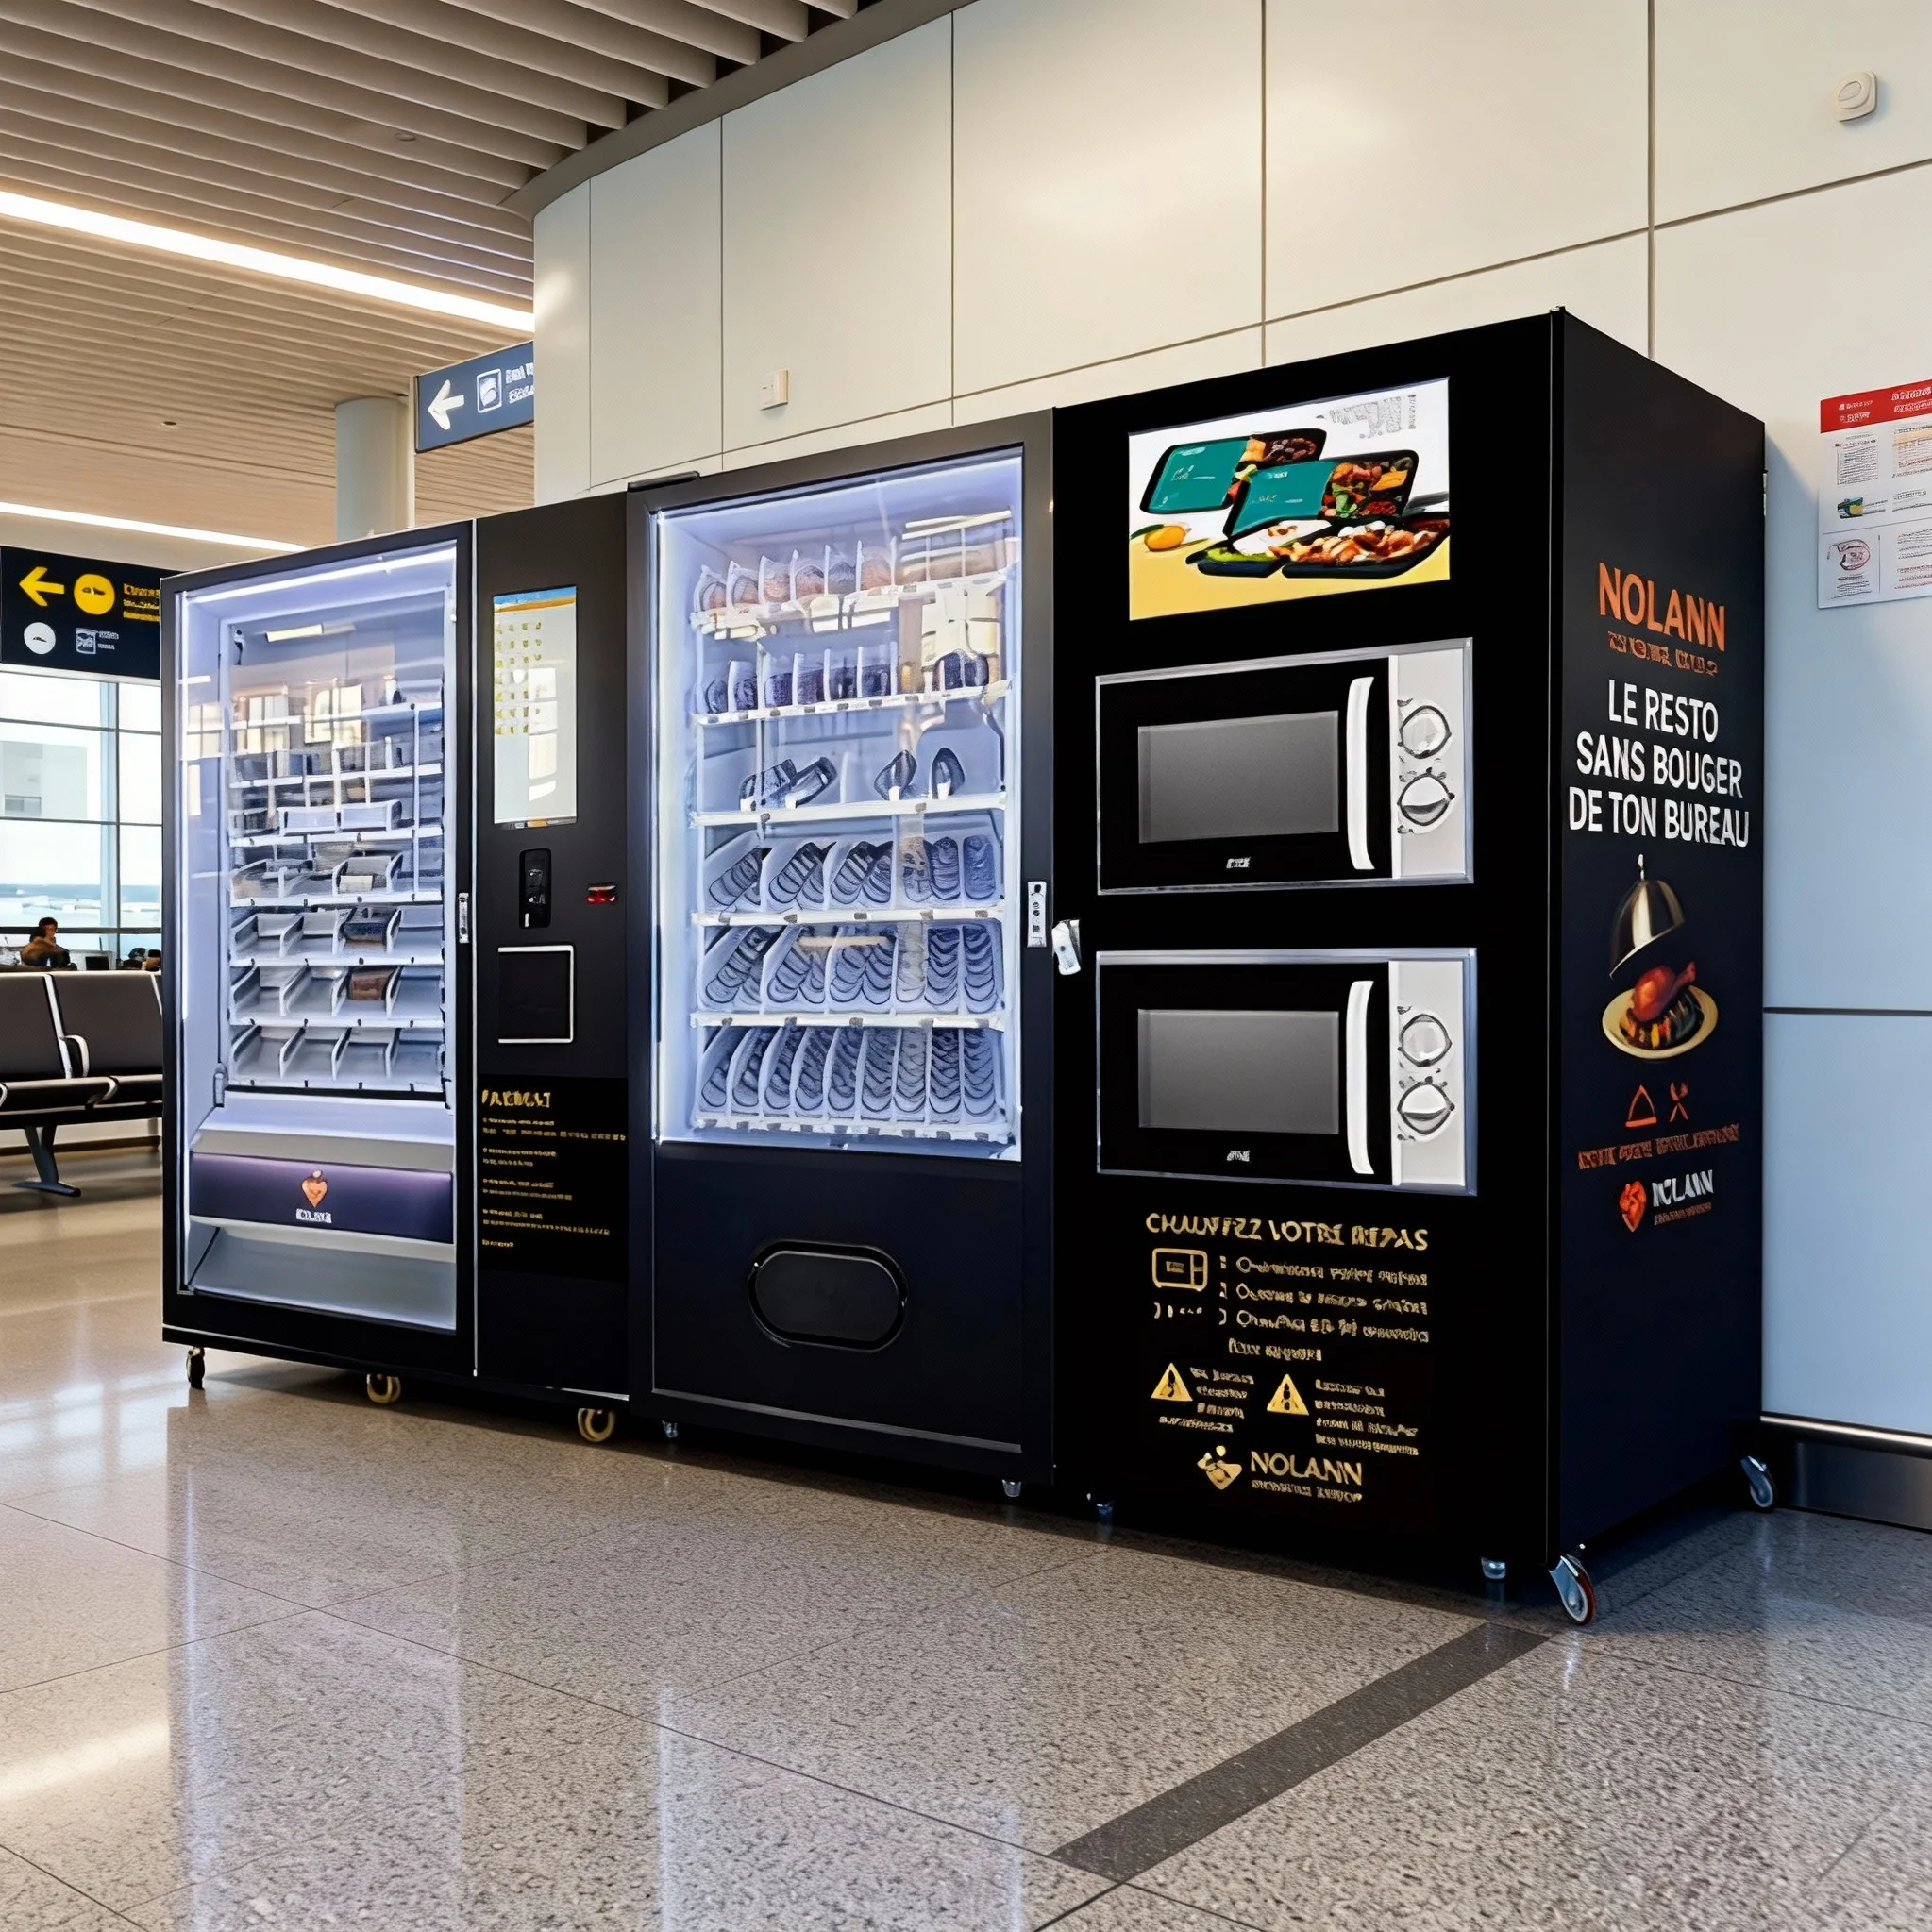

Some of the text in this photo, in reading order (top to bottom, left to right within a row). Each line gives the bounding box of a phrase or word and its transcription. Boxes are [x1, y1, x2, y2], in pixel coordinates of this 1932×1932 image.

[1599, 562, 1725, 652] NOLANN
[1608, 679, 1719, 743] LE RESTO
[1576, 731, 1743, 798] SANS BOUGER
[1569, 786, 1750, 848] DE TON BUREAU
[1251, 1450, 1362, 1486] NOLANN
